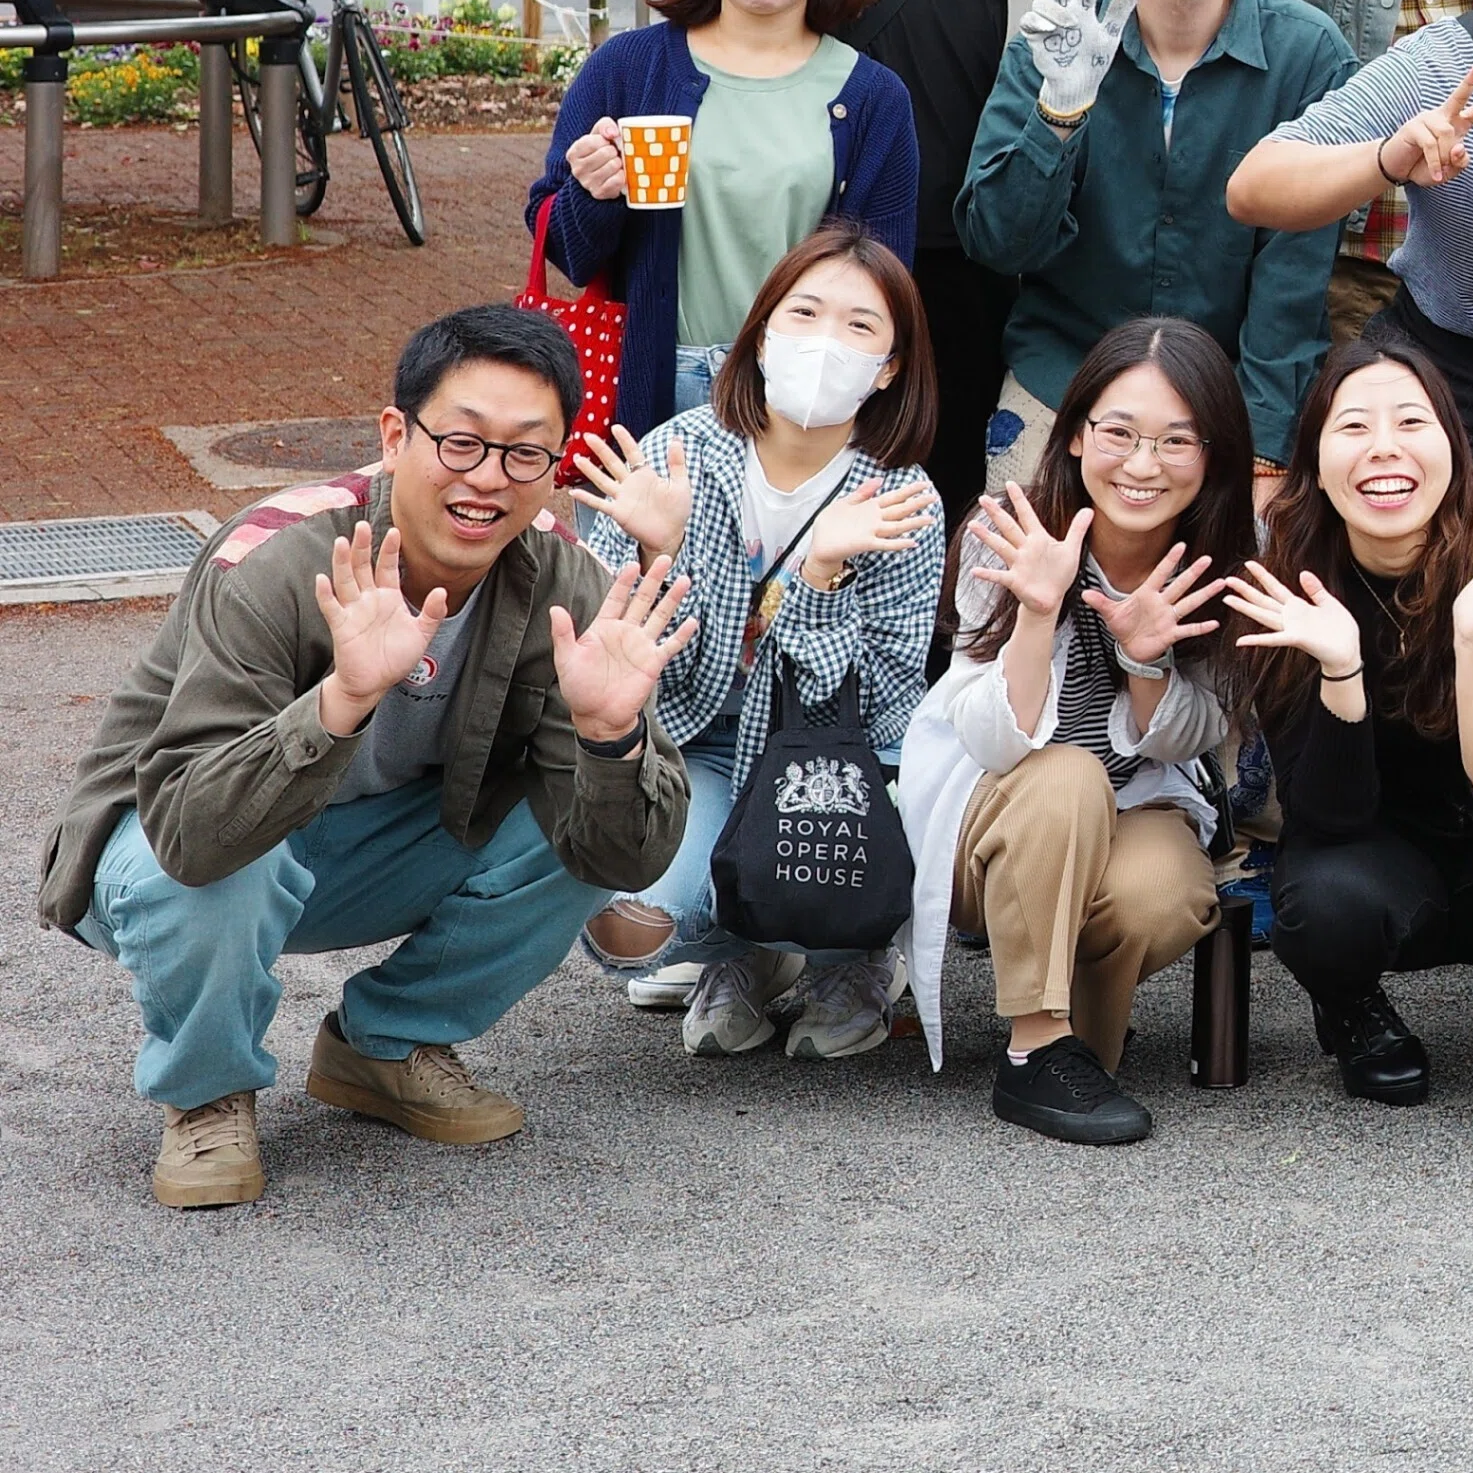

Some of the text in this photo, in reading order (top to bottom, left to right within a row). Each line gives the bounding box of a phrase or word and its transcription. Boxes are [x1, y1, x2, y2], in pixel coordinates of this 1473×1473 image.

[778, 819, 869, 840] ROYAL
[776, 840, 868, 864] OPERA
[775, 863, 865, 888] HOUSE
